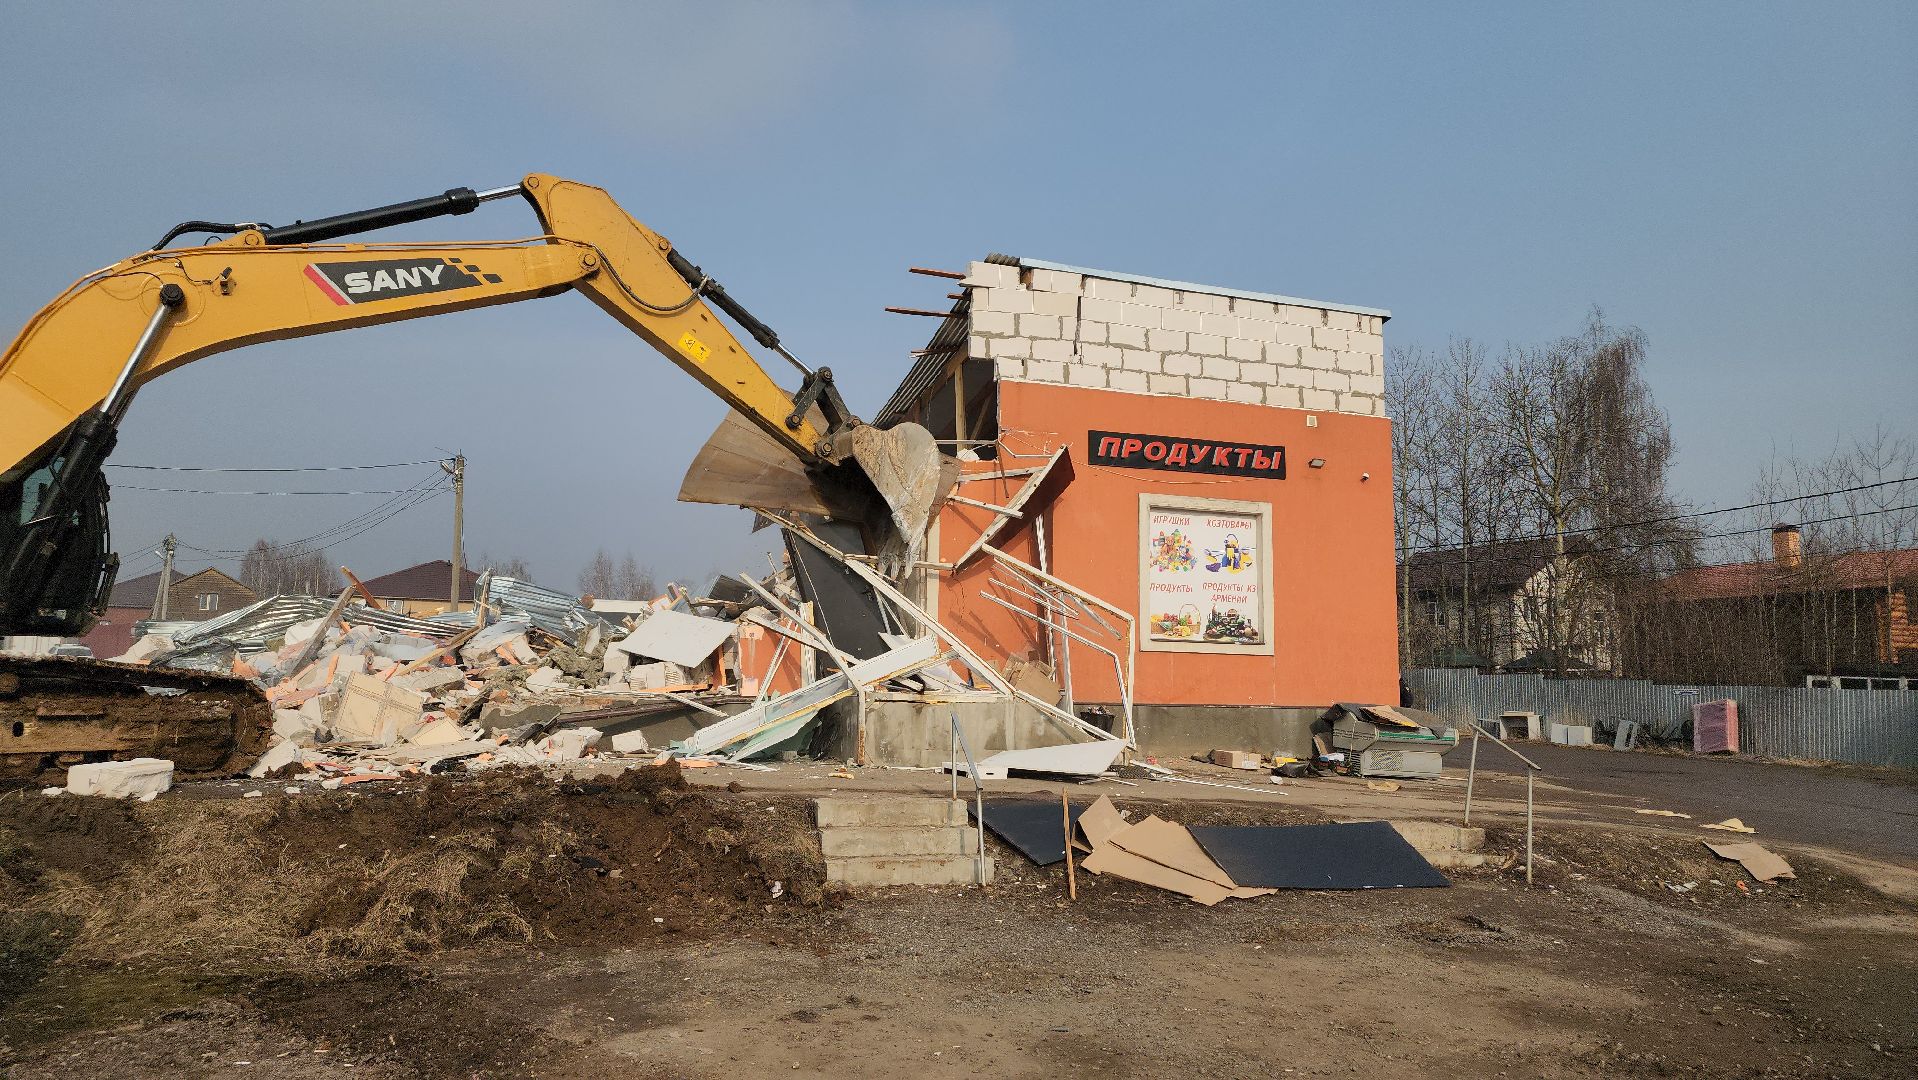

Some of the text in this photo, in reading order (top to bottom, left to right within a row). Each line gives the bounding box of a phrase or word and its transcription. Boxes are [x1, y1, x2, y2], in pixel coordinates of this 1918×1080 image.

[344, 264, 444, 294] SANY
[1097, 436, 1282, 470] ПРОДУКТЫ
[1153, 515, 1191, 526] ИГРУШКИ
[1206, 518, 1252, 529] ХОЗТОВАРЫ
[1149, 583, 1193, 594] ПРОДУКТЫ
[1202, 582, 1257, 593] ПРОДУКТЫ ИЗ
[1210, 594, 1248, 604] АРМЕНИИ
